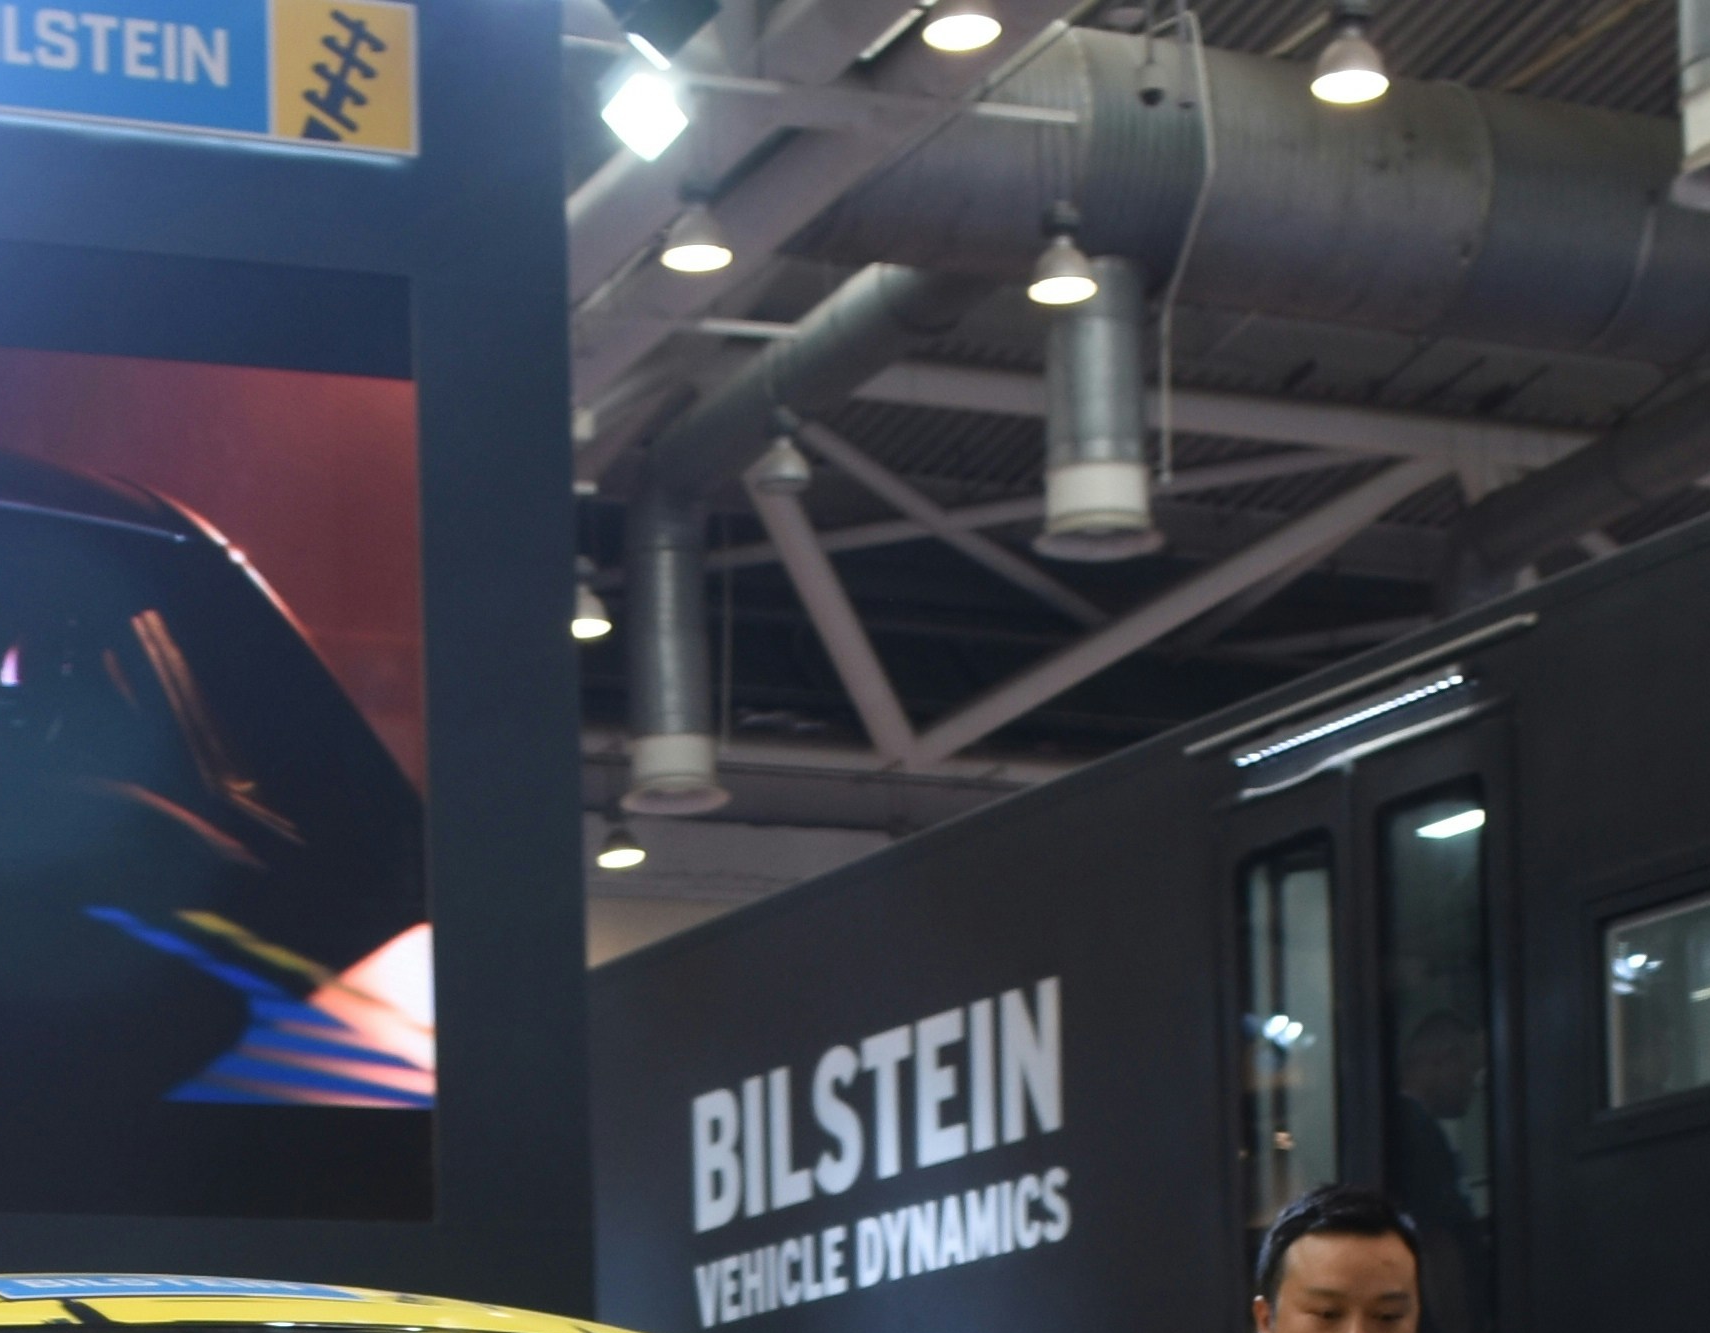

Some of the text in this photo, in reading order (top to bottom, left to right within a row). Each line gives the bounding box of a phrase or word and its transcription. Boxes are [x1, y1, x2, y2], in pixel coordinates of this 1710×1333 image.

[693, 976, 1062, 1233] BILSTEIN
[694, 1166, 1071, 1330] VEHICLE DYNAMICS
